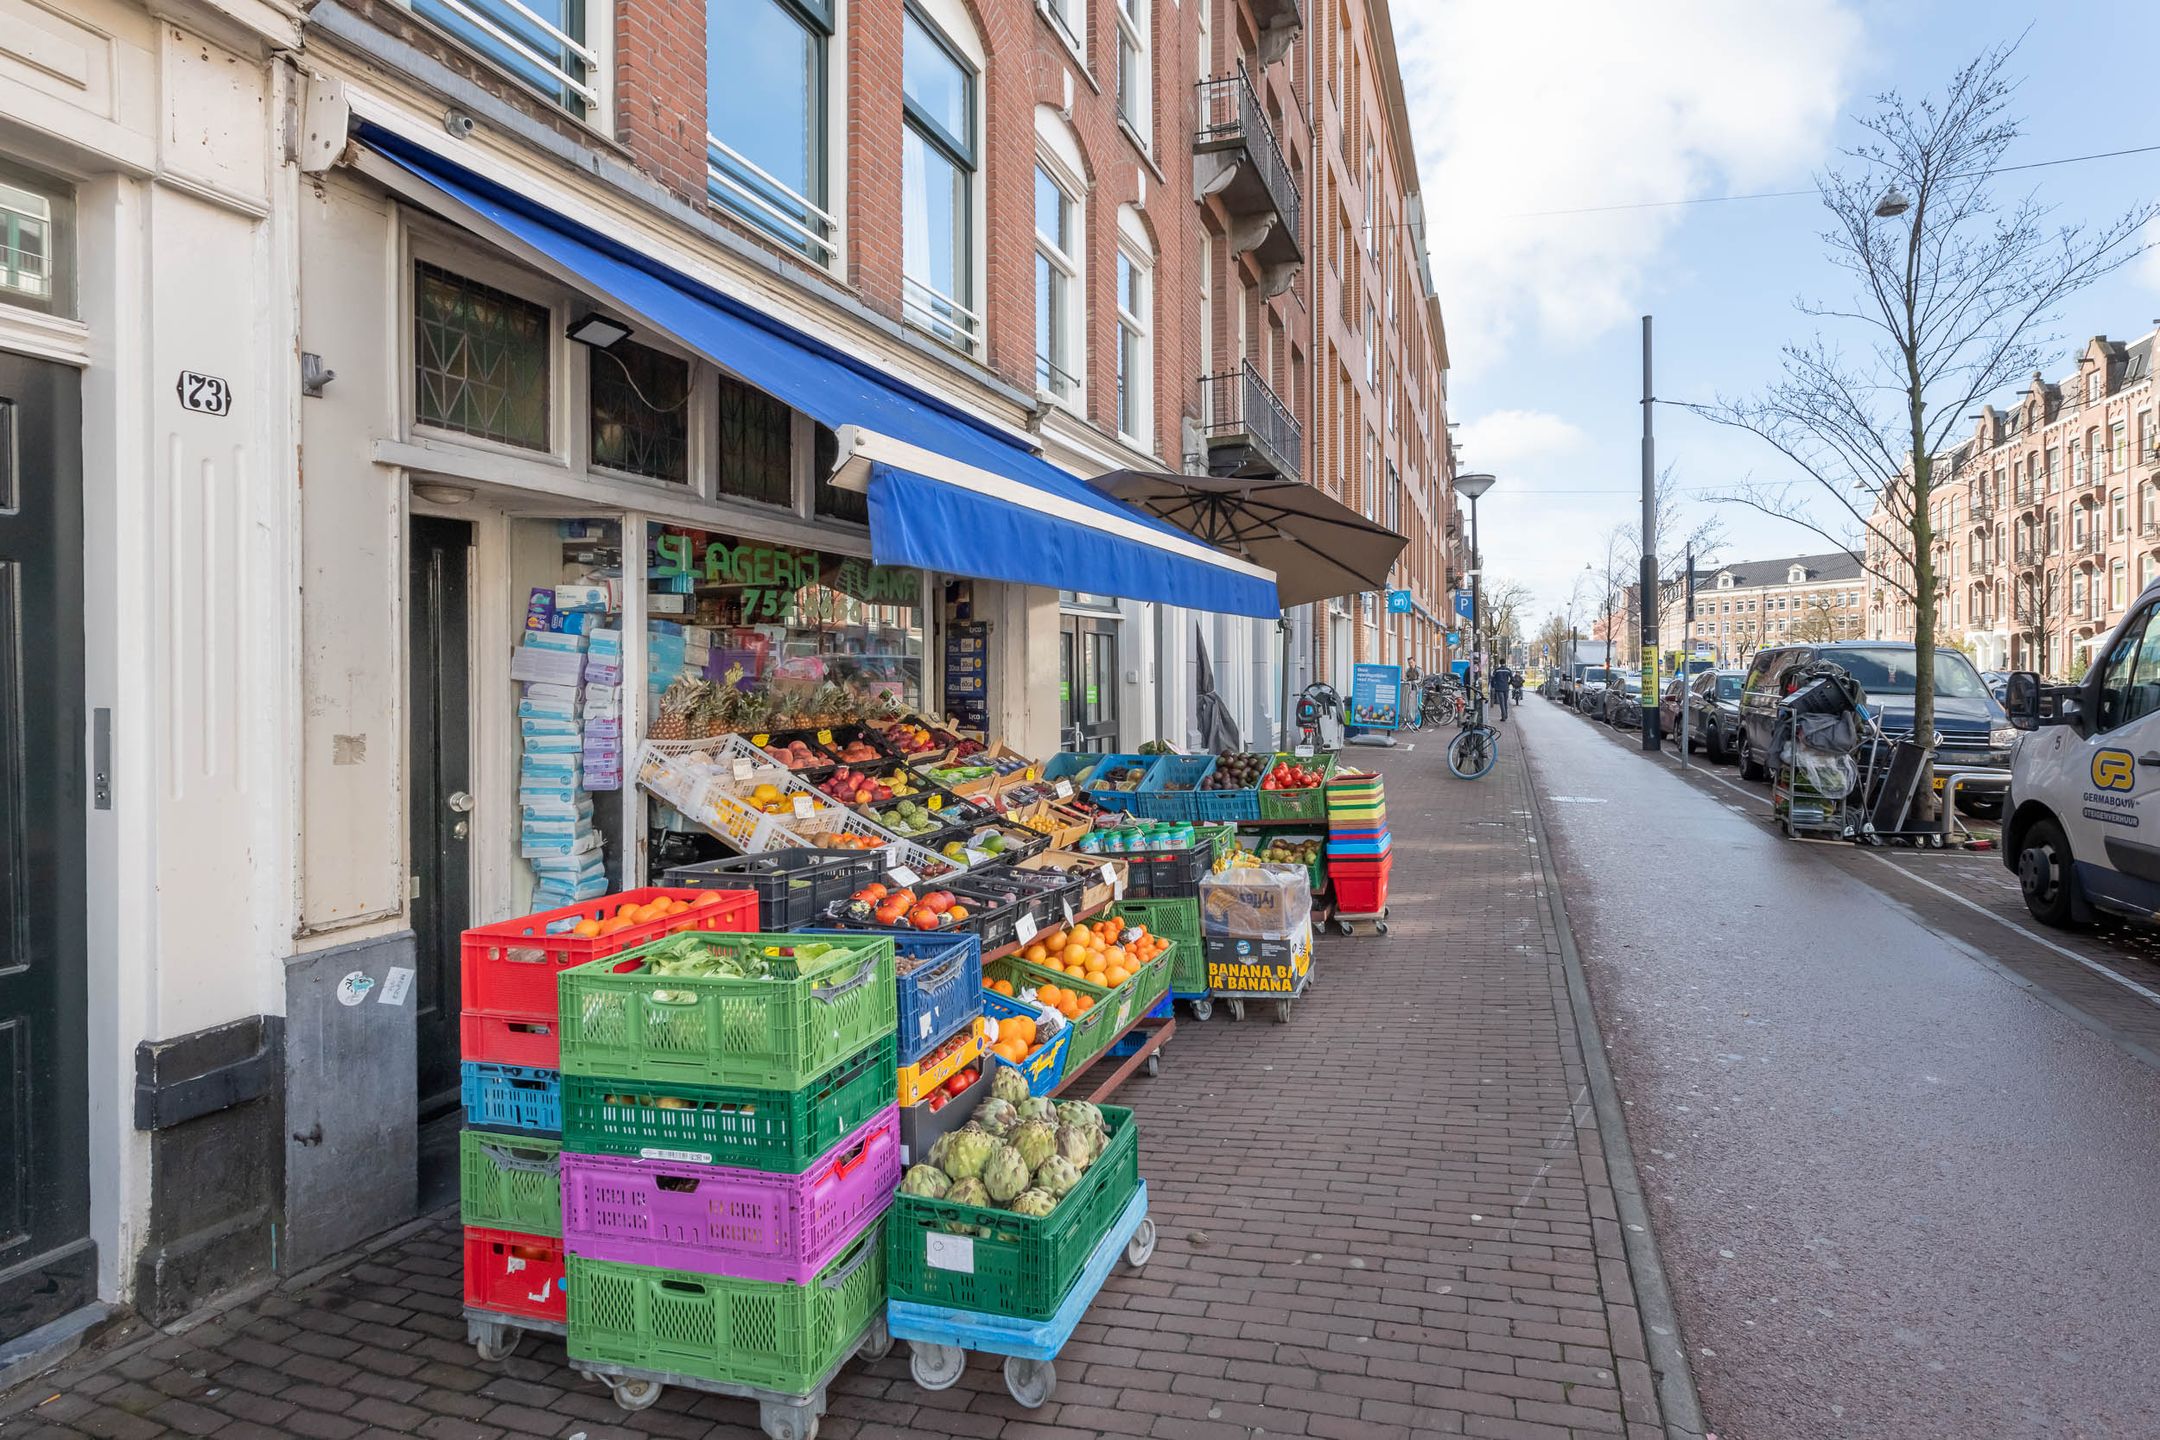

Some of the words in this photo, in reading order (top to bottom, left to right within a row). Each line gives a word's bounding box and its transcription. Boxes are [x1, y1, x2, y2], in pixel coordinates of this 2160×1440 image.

[188, 373, 223, 412] 73
[656, 534, 820, 588] SLAGERIJ
[742, 588, 796, 618] 752
[1461, 598, 1469, 611] P
[2055, 735, 2061, 750] 5
[2083, 792, 2135, 808] GERMABOUW
[1208, 962, 1272, 978] BANANA
[1227, 976, 1293, 992] BANANA
